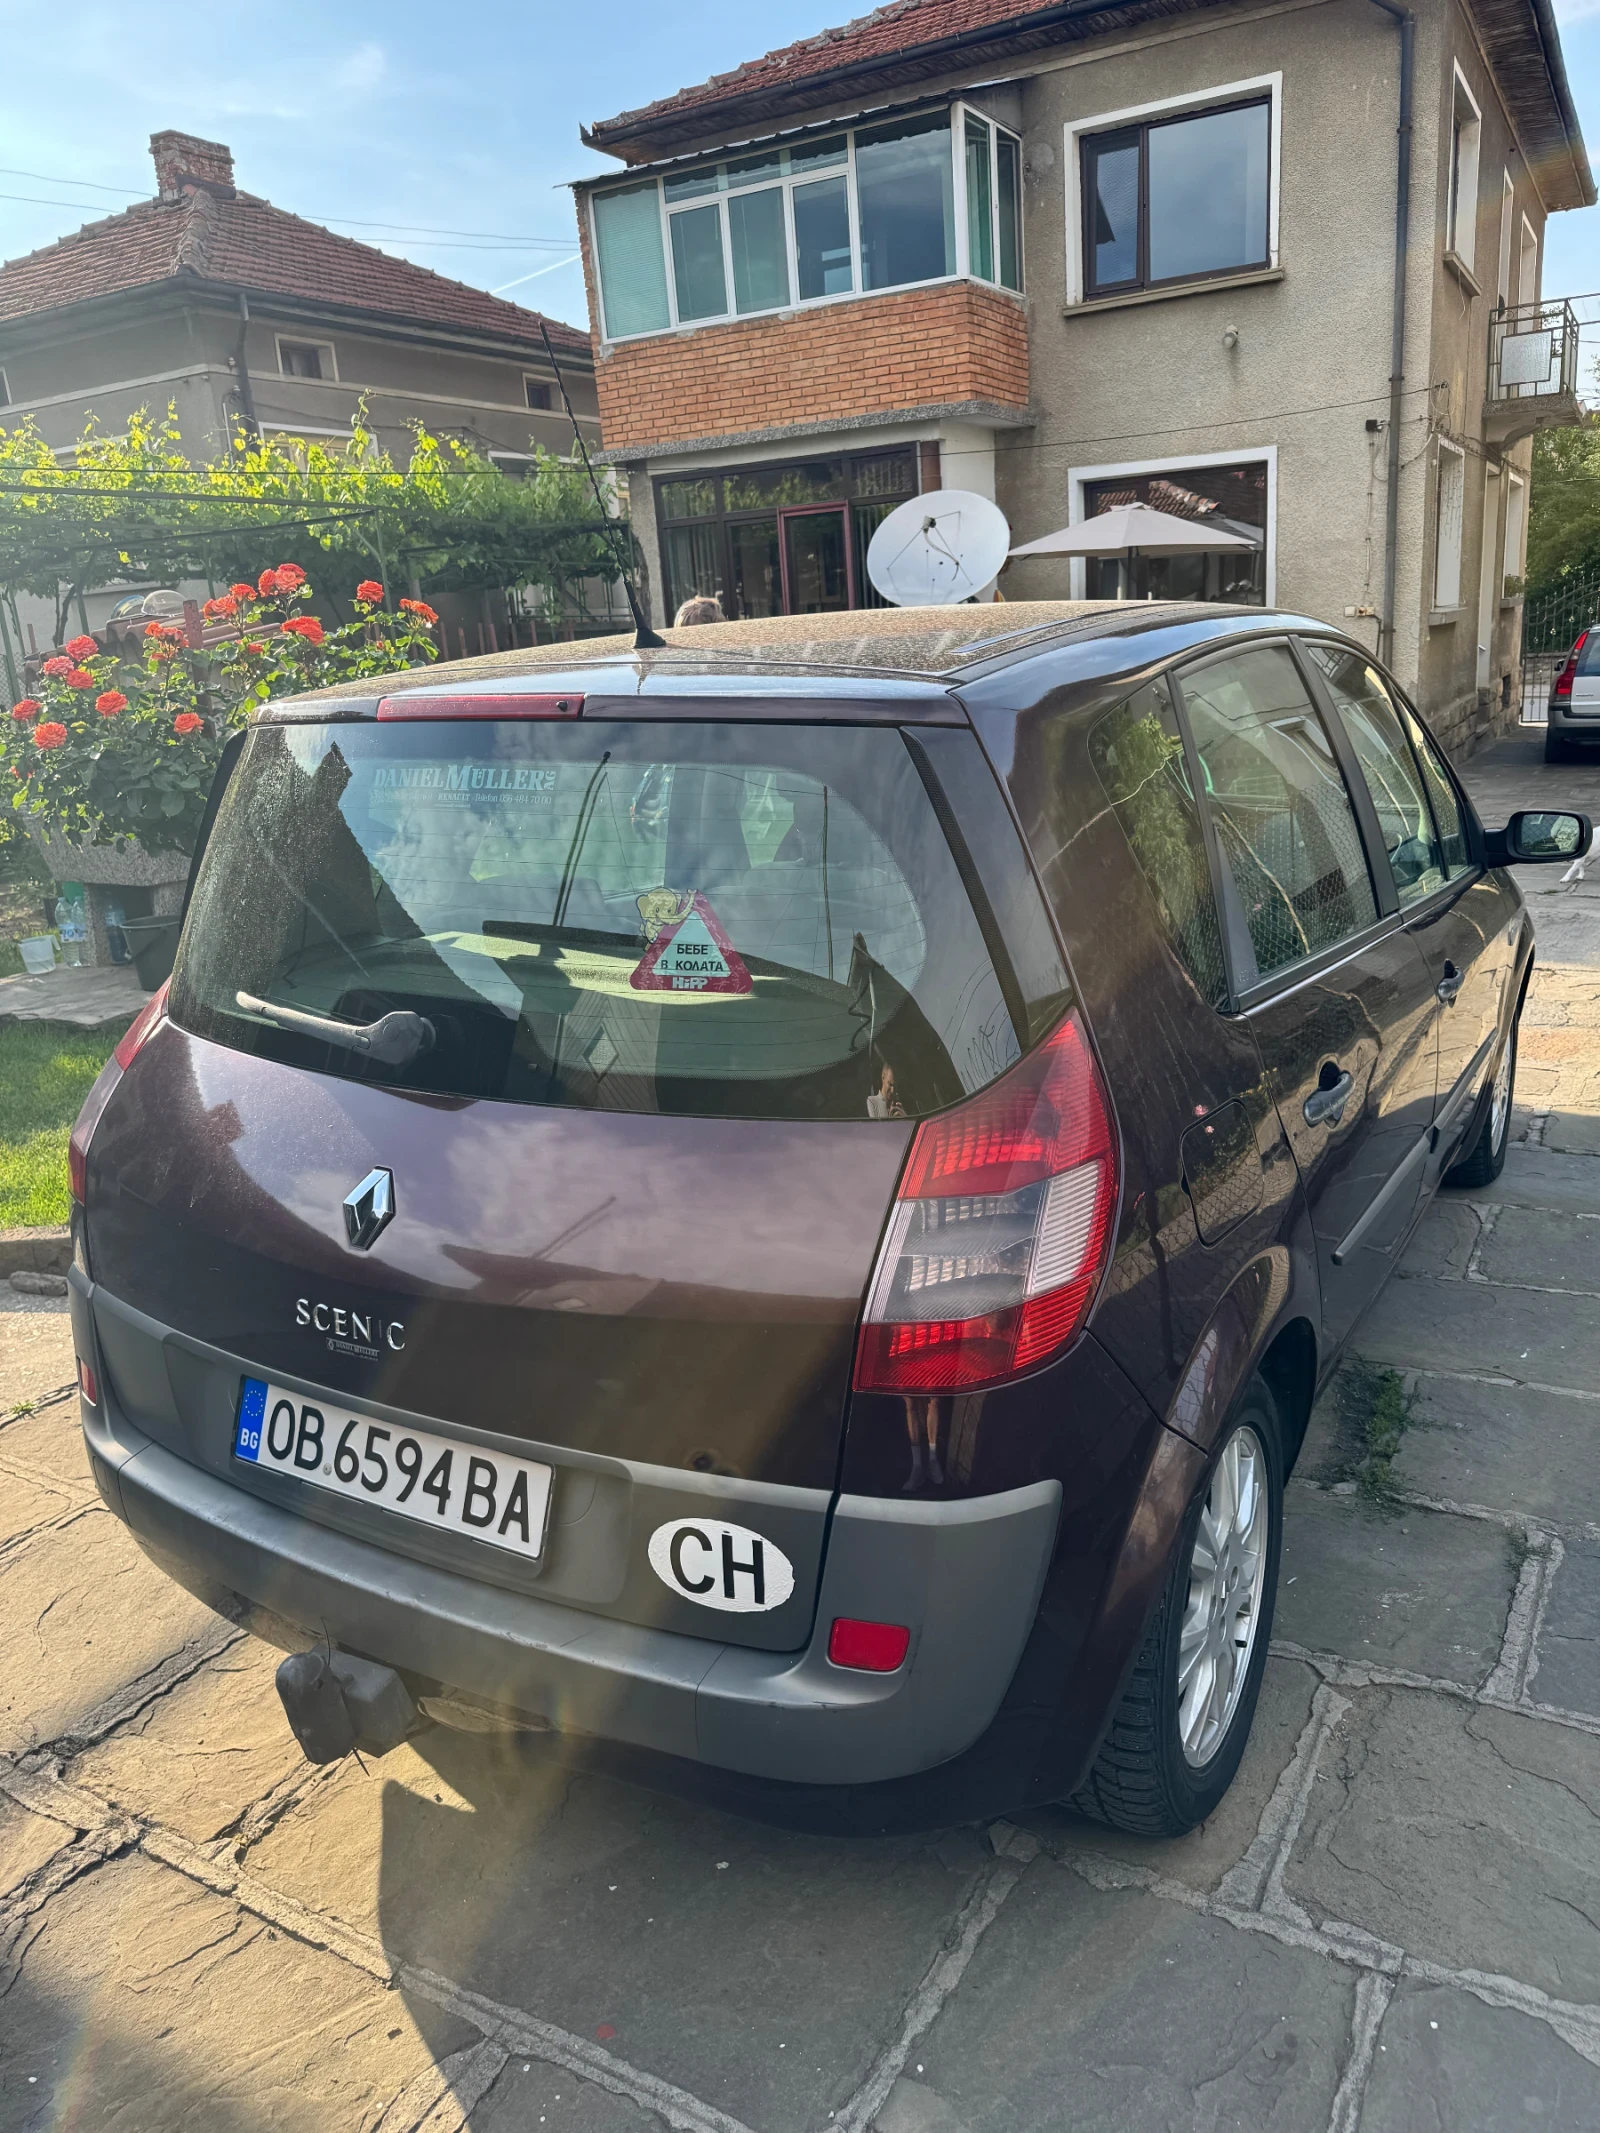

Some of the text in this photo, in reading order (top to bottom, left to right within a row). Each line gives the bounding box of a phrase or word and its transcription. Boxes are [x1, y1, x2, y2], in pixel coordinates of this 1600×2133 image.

[373, 768, 444, 788] DANIEL
[475, 793, 498, 803] Telefon
[676, 944, 709, 955] БЕБЕ
[660, 960, 724, 972] В КОЛАТА
[240, 1427, 259, 1450] BG
[670, 1526, 765, 1605] CH
